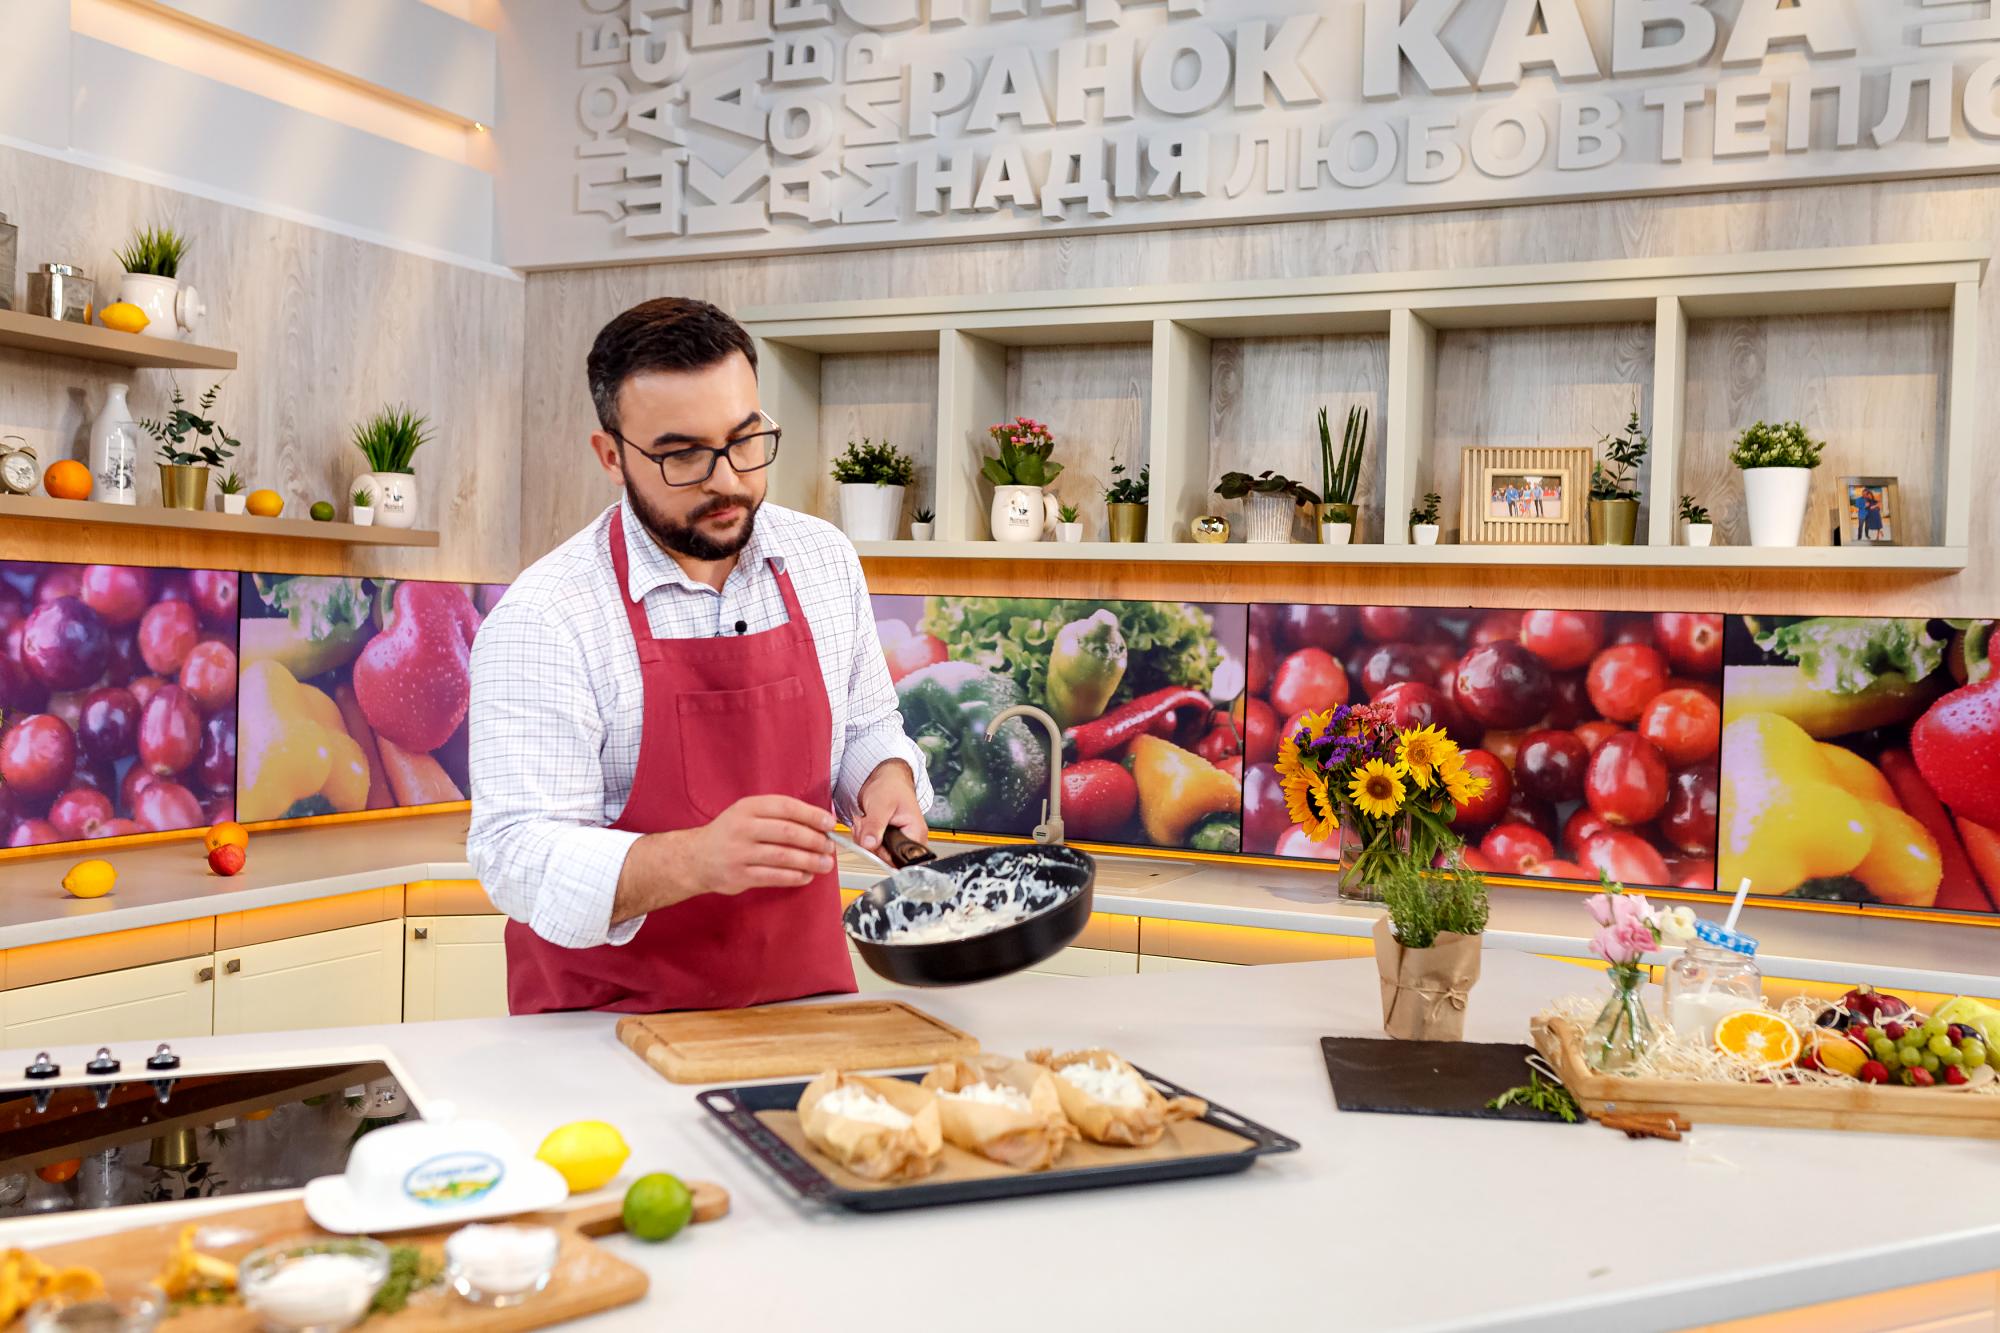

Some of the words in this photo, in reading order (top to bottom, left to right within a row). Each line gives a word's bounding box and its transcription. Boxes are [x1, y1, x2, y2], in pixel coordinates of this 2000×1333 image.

[909, 12, 1320, 138] РАНОК
[1361, 0, 1857, 99] КАВА
[575, 0, 629, 222] ЛЮБ
[841, 33, 900, 223] МИР
[1224, 95, 1623, 199] ЛЮБОВ
[915, 126, 1208, 221] НАДІЯ
